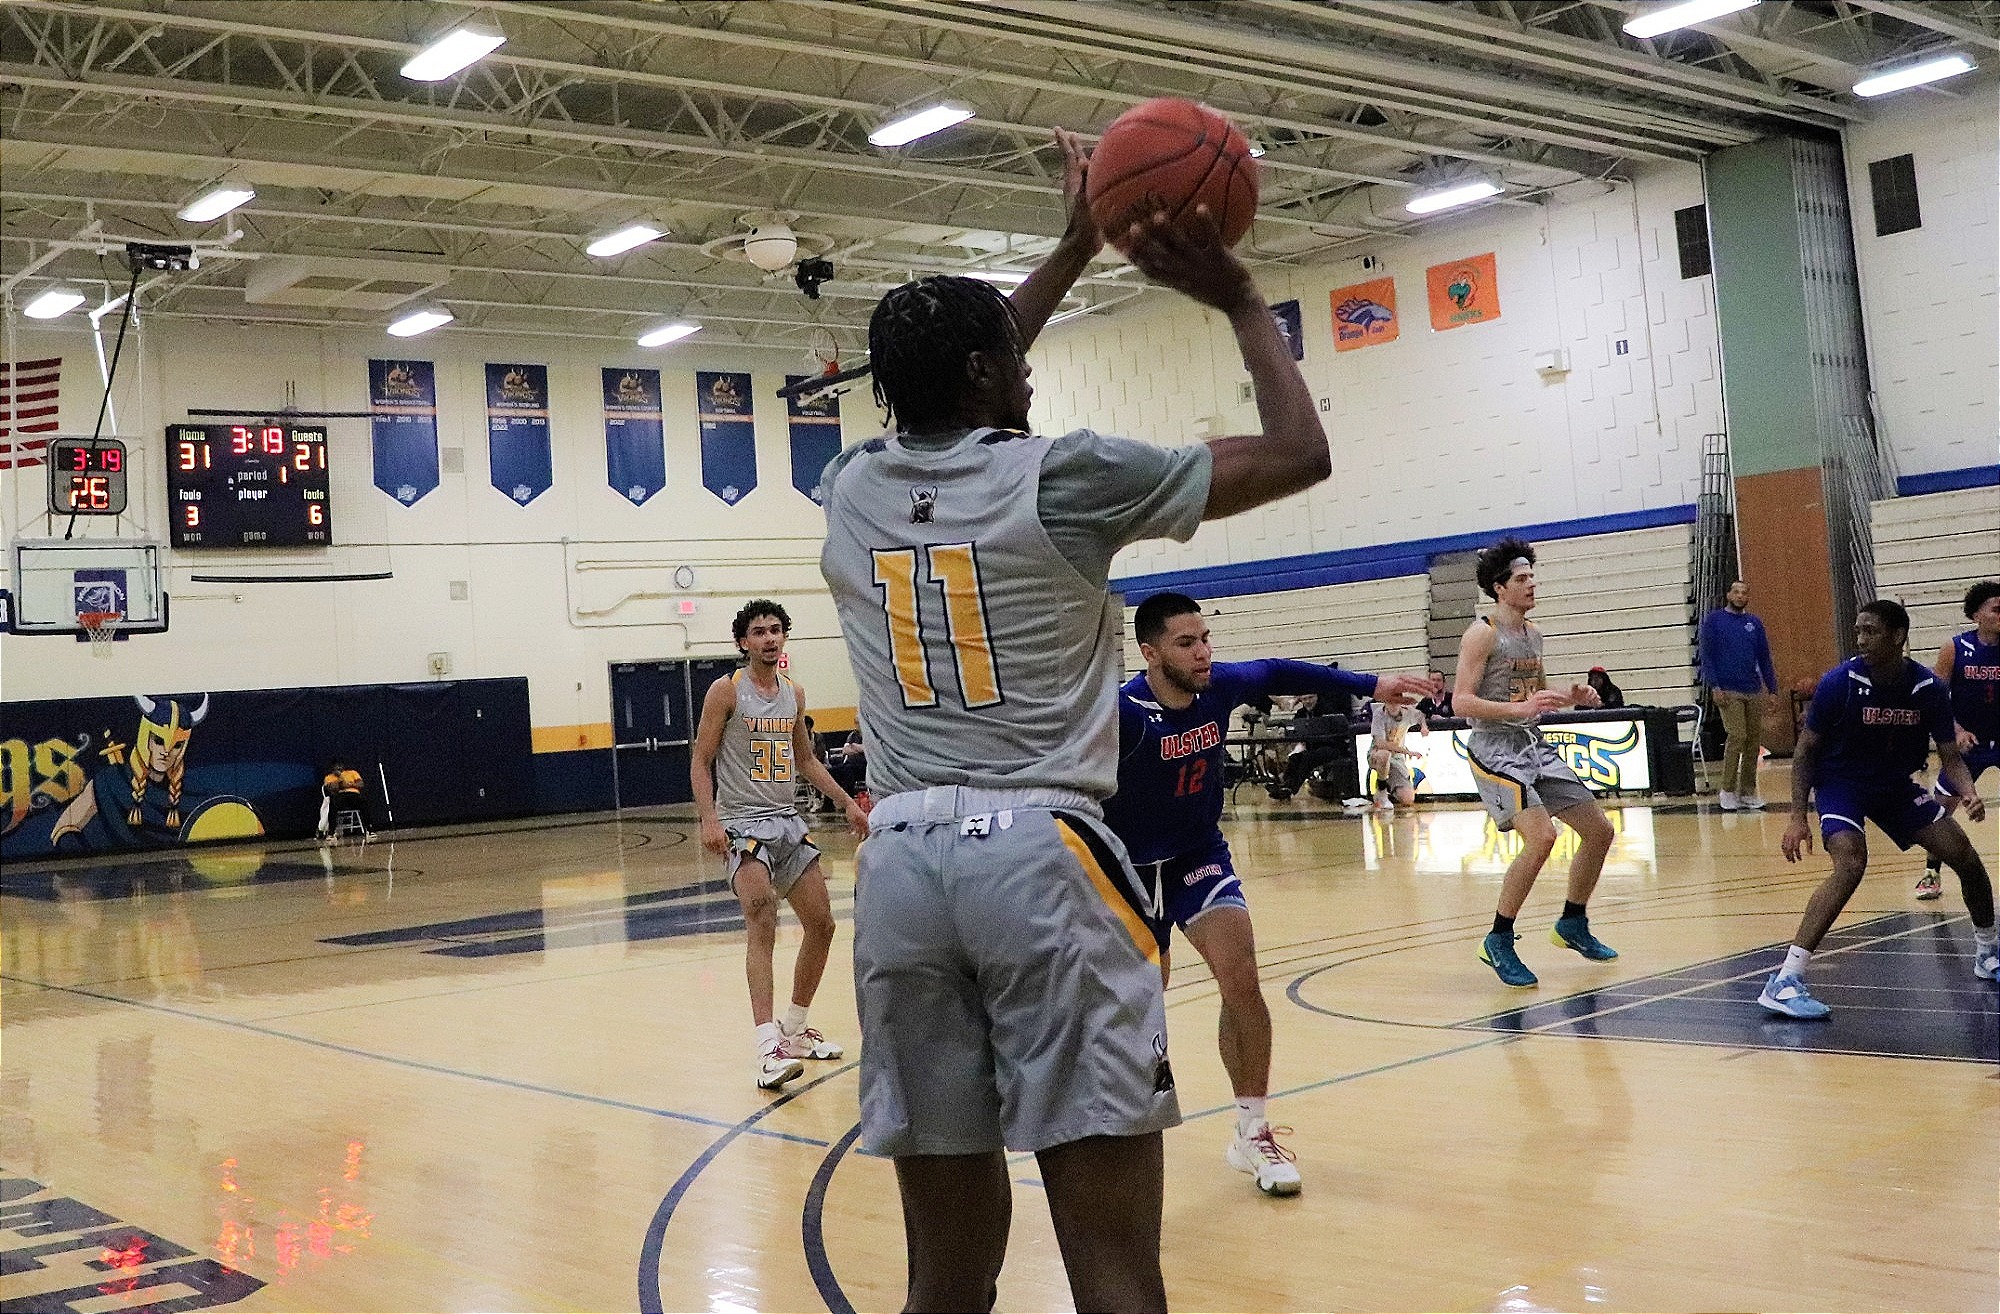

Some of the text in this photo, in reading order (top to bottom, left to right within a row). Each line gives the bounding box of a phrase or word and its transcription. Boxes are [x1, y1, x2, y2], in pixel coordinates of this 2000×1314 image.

[179, 429, 206, 441] Home
[232, 427, 284, 454] 3:19
[291, 430, 323, 442] Guests
[73, 447, 121, 473] 3:19
[179, 442, 211, 470] 31
[294, 444, 326, 470] 21
[237, 469, 268, 481] period
[70, 477, 109, 509] 26
[179, 488, 202, 501] fouls
[238, 488, 268, 501] player
[303, 489, 325, 500] fouls
[186, 504, 199, 526] 3
[309, 504, 323, 525] 6
[183, 532, 202, 542] won
[870, 541, 1005, 710] 11
[1862, 707, 1920, 725] ULSTER
[1161, 721, 1220, 760] ULSTER
[750, 739, 791, 782] 35
[1174, 758, 1208, 797] 12
[1183, 864, 1223, 886] ULSTER
